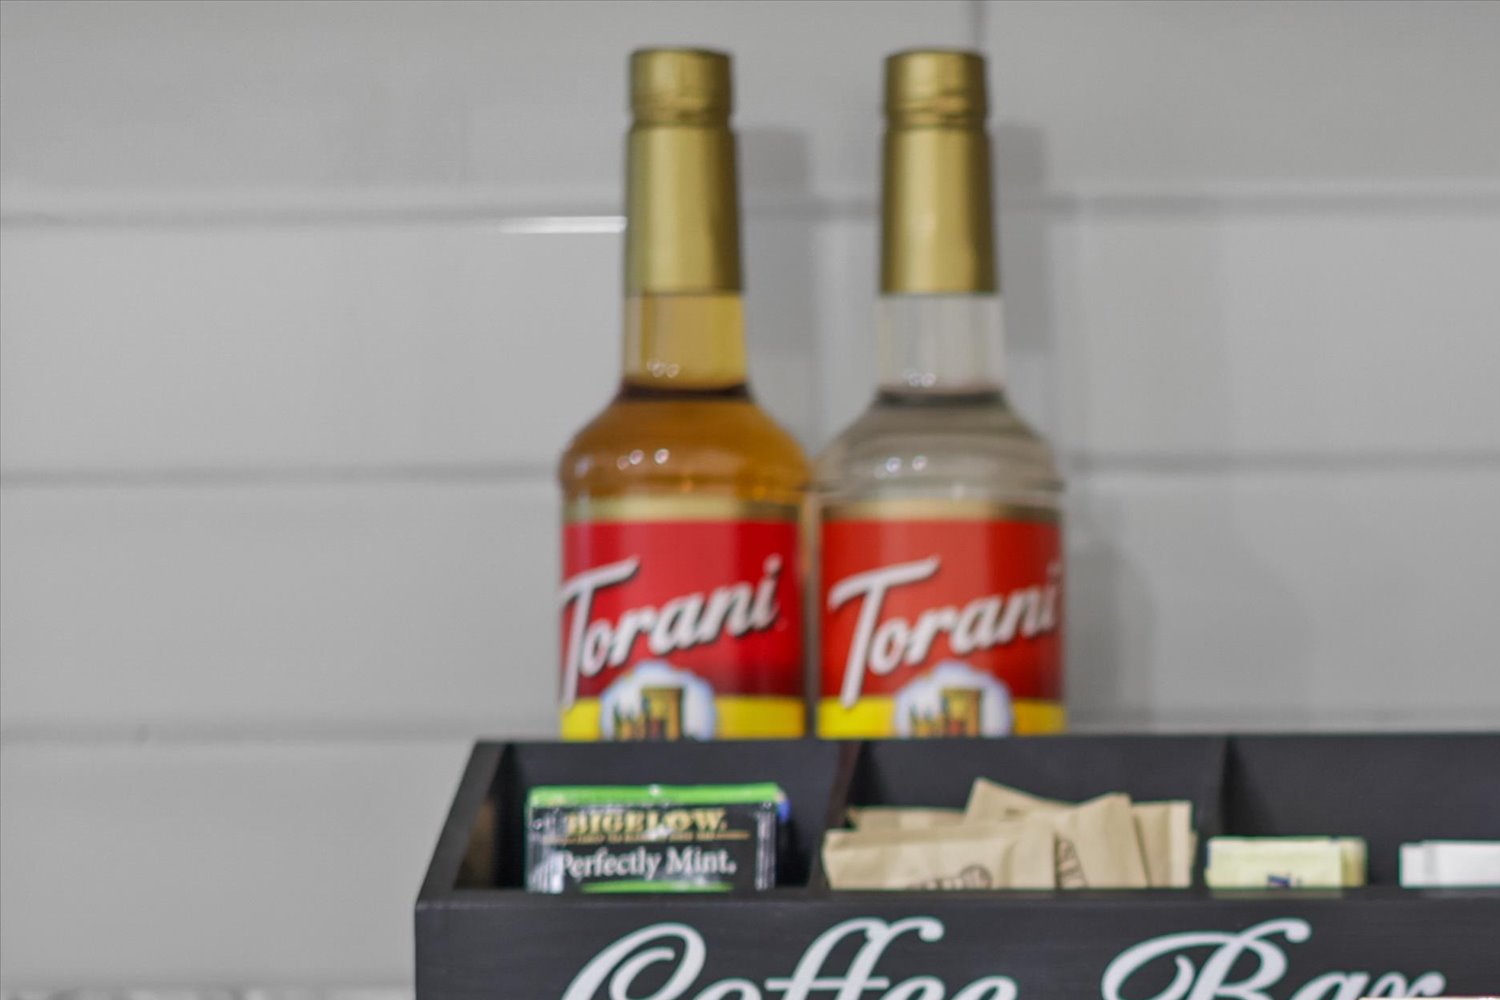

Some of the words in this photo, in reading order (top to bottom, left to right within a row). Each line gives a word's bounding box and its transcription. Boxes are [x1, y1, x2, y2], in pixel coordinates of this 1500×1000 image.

[558, 553, 783, 710] Torani
[828, 555, 1064, 709] Torani
[562, 846, 662, 880] Perfectly
